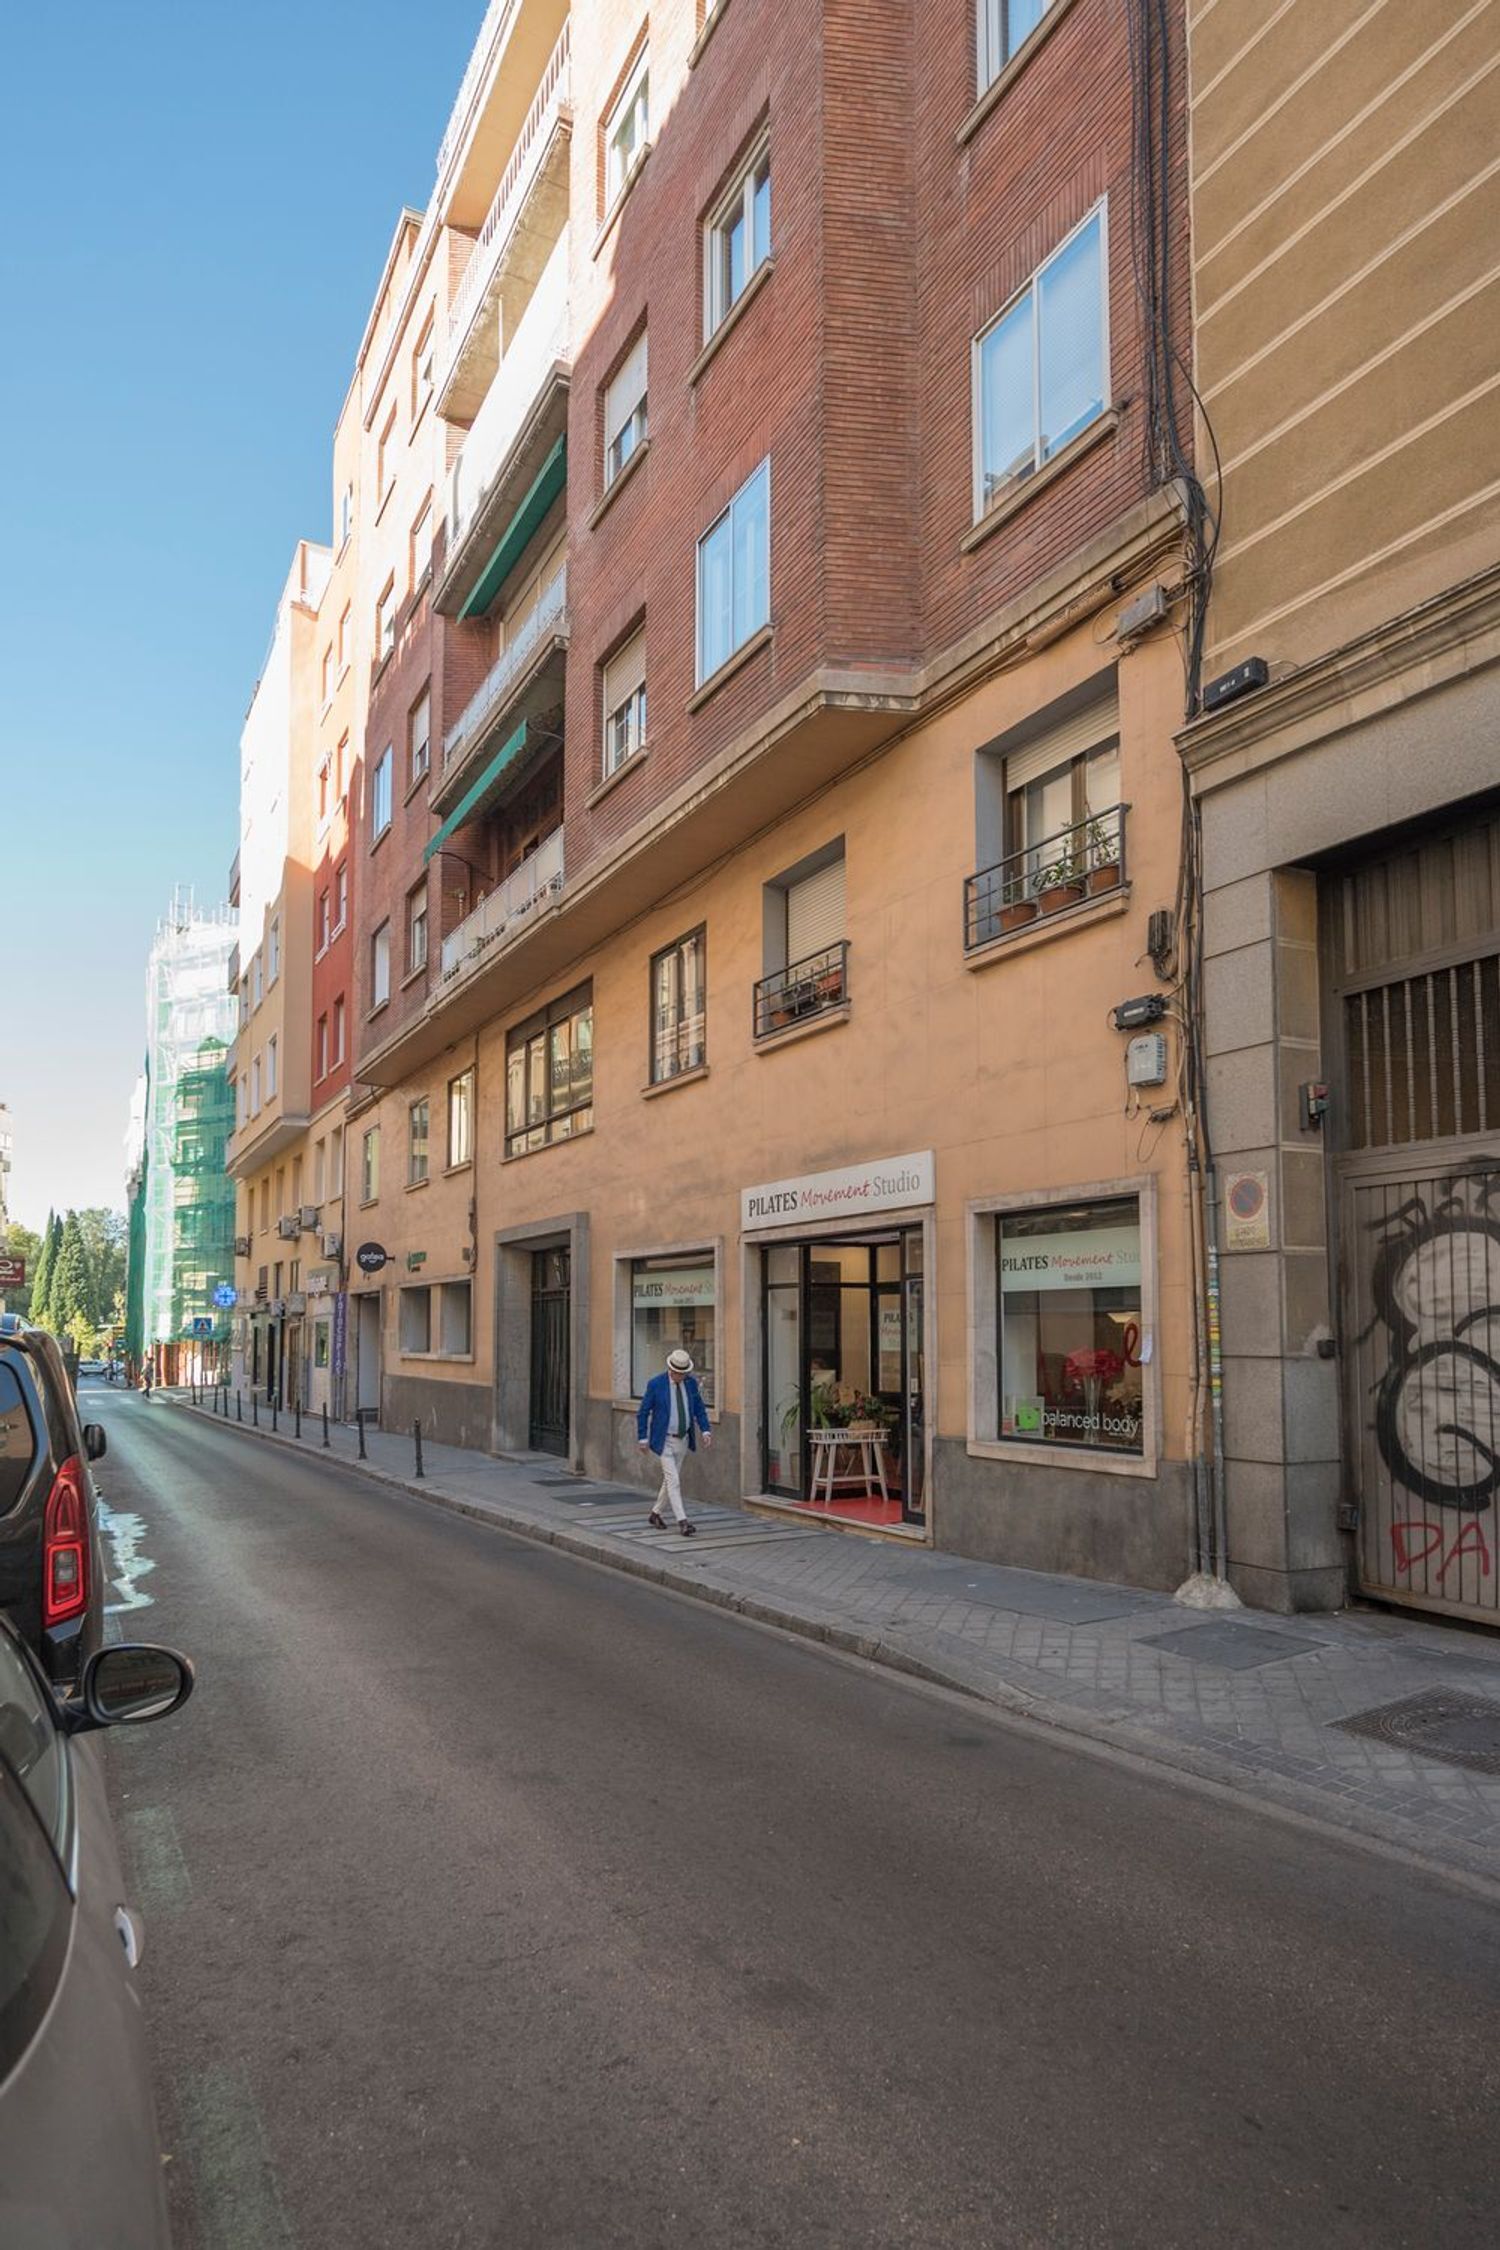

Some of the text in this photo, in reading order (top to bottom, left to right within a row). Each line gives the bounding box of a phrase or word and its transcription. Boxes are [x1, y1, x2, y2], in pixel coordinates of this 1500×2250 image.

[749, 1170, 920, 1217] PILATES Movement Studio
[1002, 1255, 1049, 1272] PILATES
[1051, 1252, 1113, 1268] Movement
[1041, 1408, 1138, 1439] balanced body
